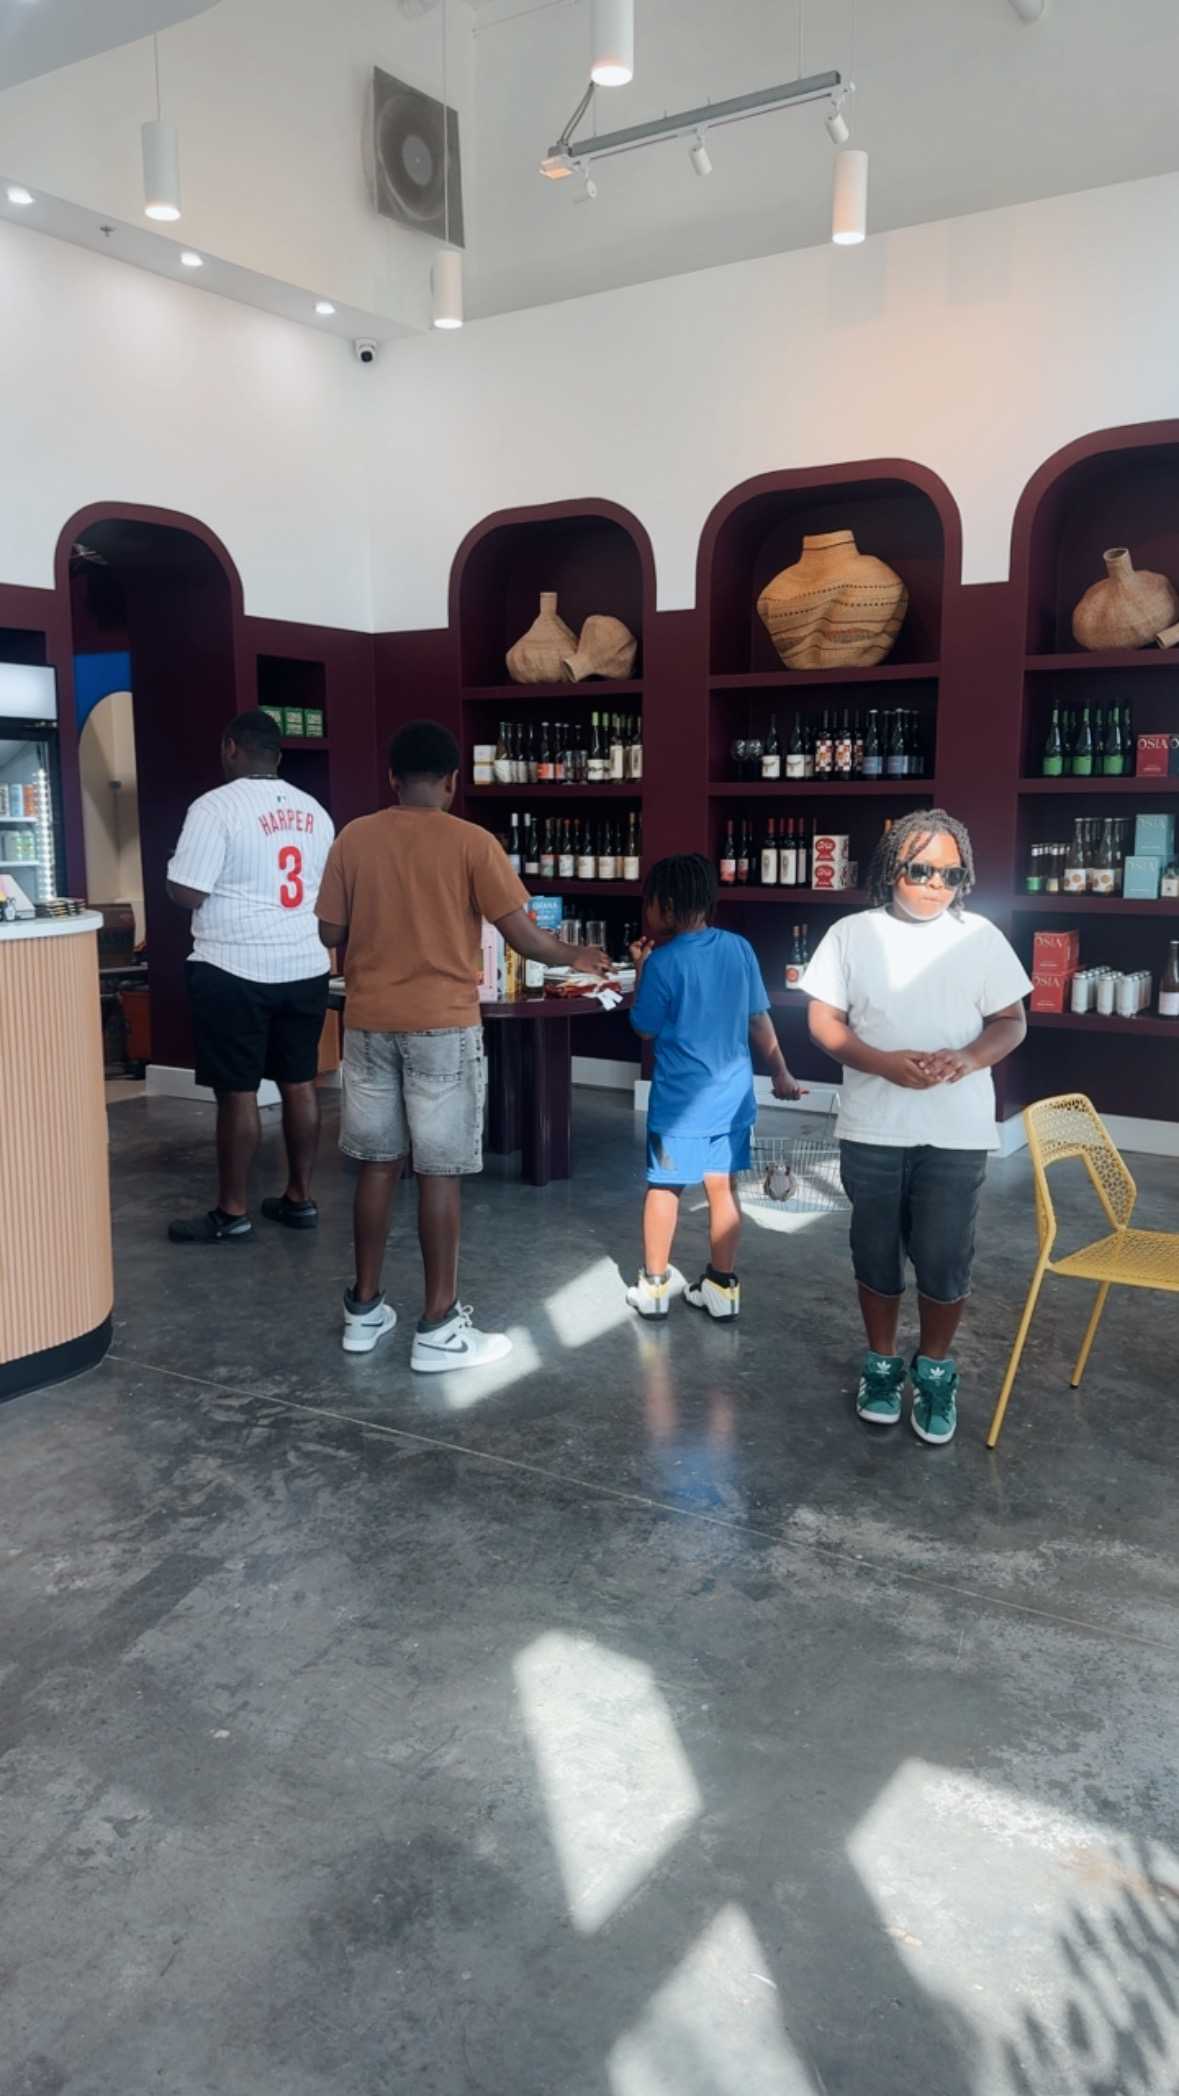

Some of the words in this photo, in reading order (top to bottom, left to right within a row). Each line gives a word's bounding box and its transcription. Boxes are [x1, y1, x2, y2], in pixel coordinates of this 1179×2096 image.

[1138, 738, 1169, 750] OSIA
[258, 809, 315, 836] HARPER
[278, 846, 304, 908] 3
[1035, 936, 1063, 948] OSIA
